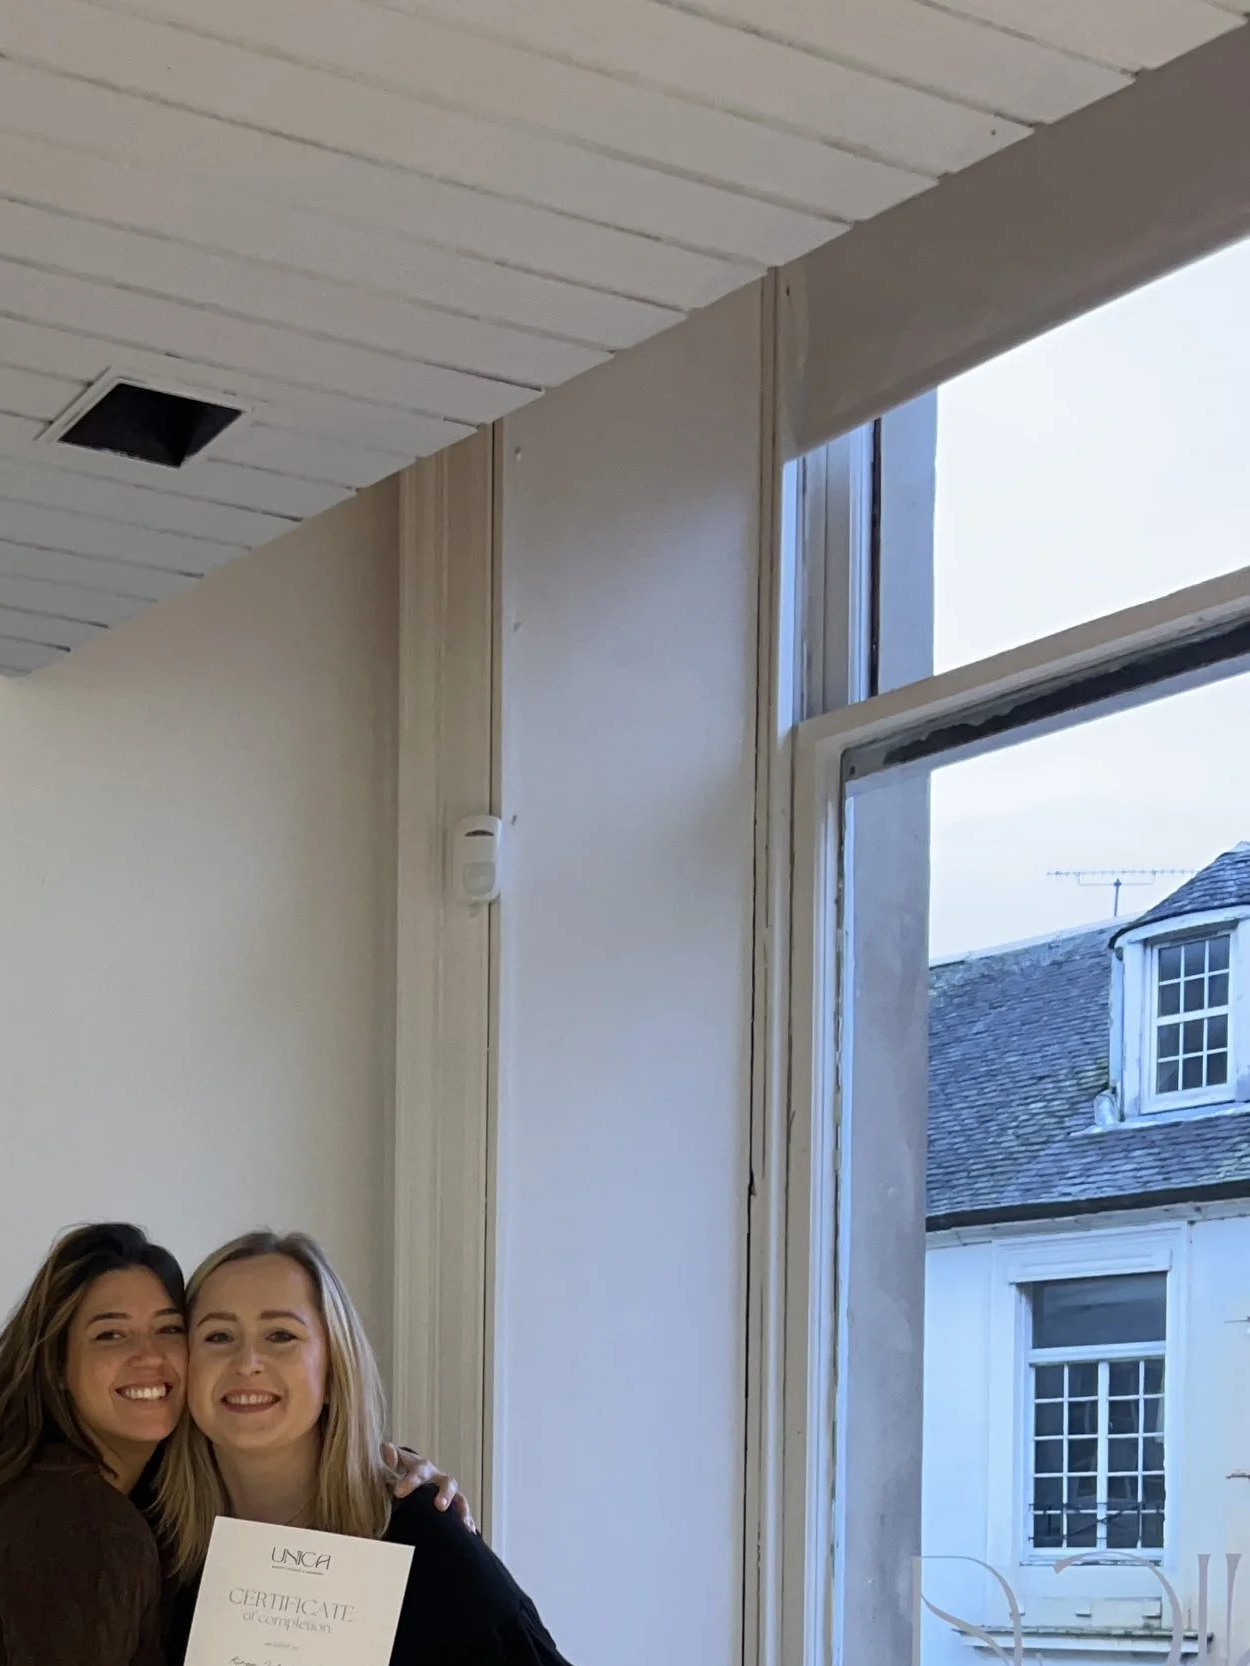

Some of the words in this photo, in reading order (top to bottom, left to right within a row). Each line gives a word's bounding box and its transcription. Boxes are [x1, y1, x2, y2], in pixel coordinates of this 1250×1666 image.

[271, 1547, 331, 1569] UNICA
[229, 1588, 355, 1622] CERTIFICATE
[242, 1609, 256, 1623] of
[258, 1615, 331, 1633] completion
